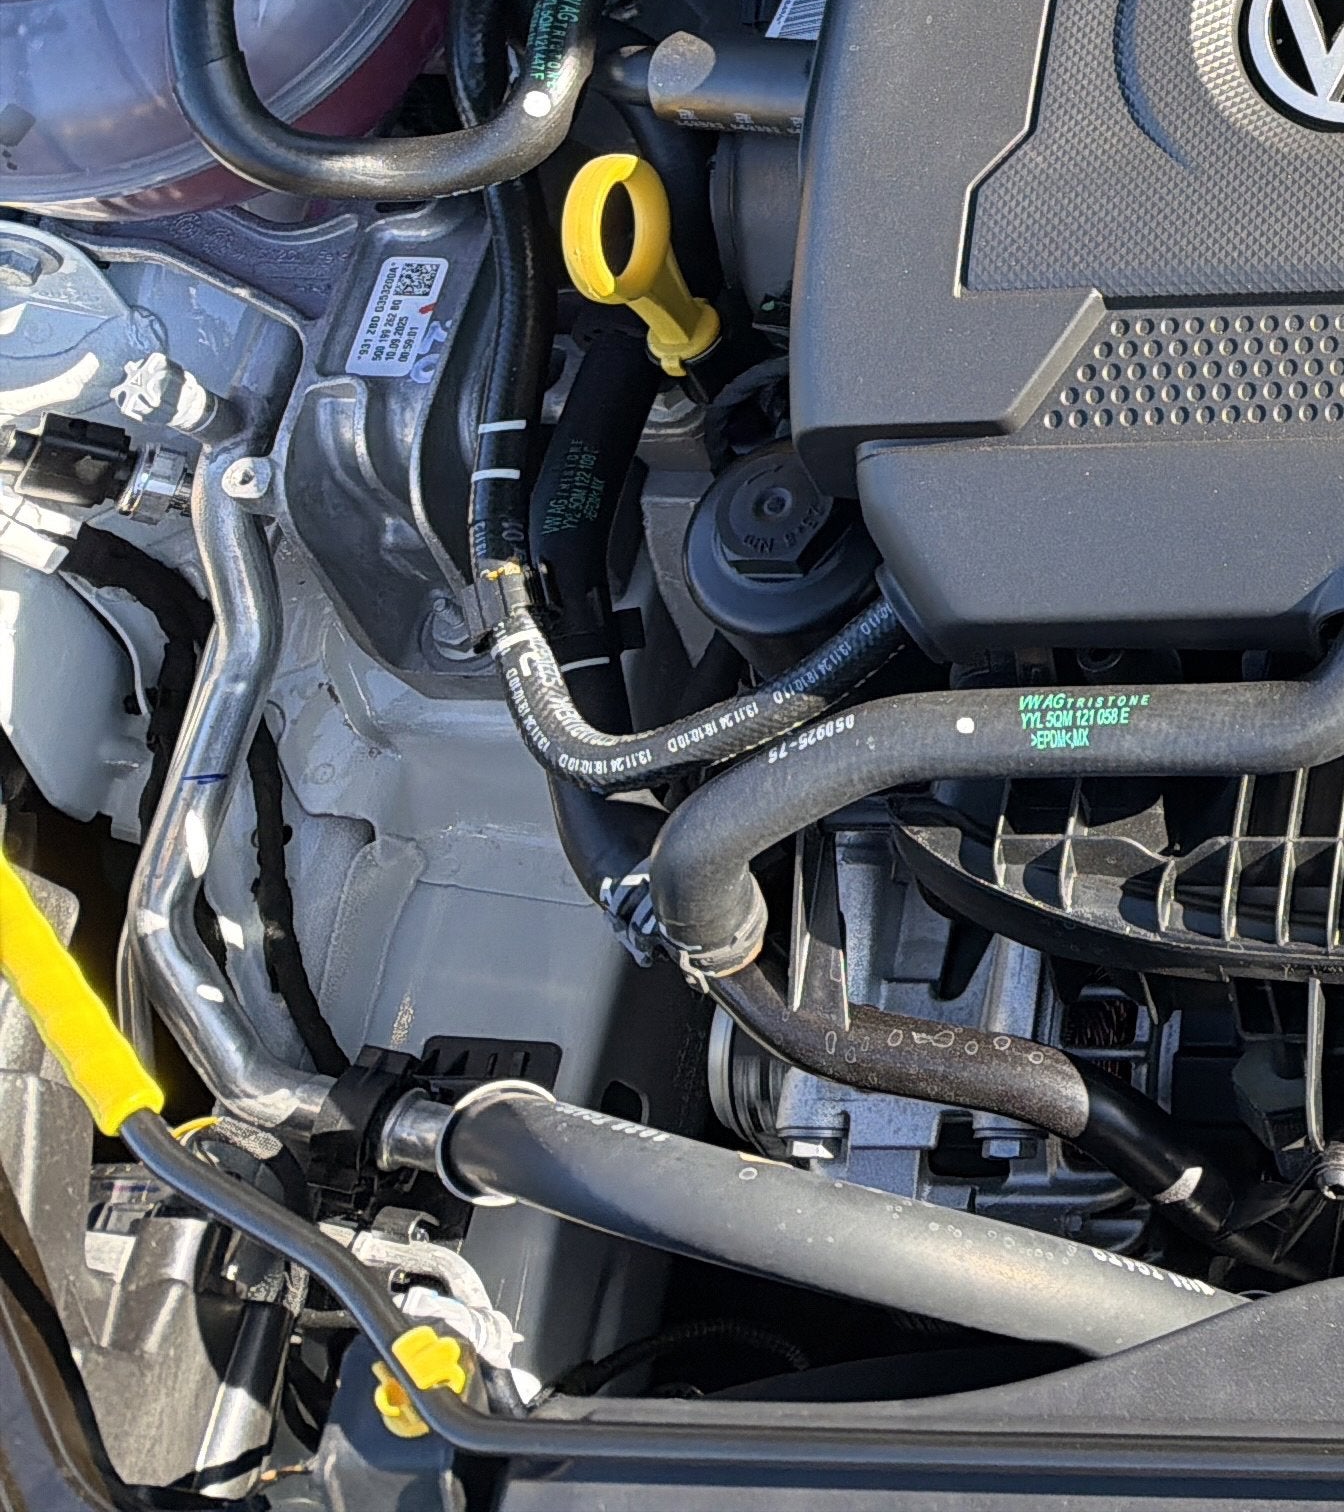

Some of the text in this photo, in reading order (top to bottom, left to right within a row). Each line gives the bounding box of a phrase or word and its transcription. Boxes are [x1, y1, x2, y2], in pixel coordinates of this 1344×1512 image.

[368, 315, 380, 335] ZBD
[384, 312, 397, 327] 262
[385, 315, 409, 360] 10.09.2025
[400, 326, 420, 362] 00:59:01
[719, 702, 759, 729] 13.11.24
[1021, 708, 1130, 729] YYL 5QM 121 058 E
[768, 713, 855, 764] 050925-75
